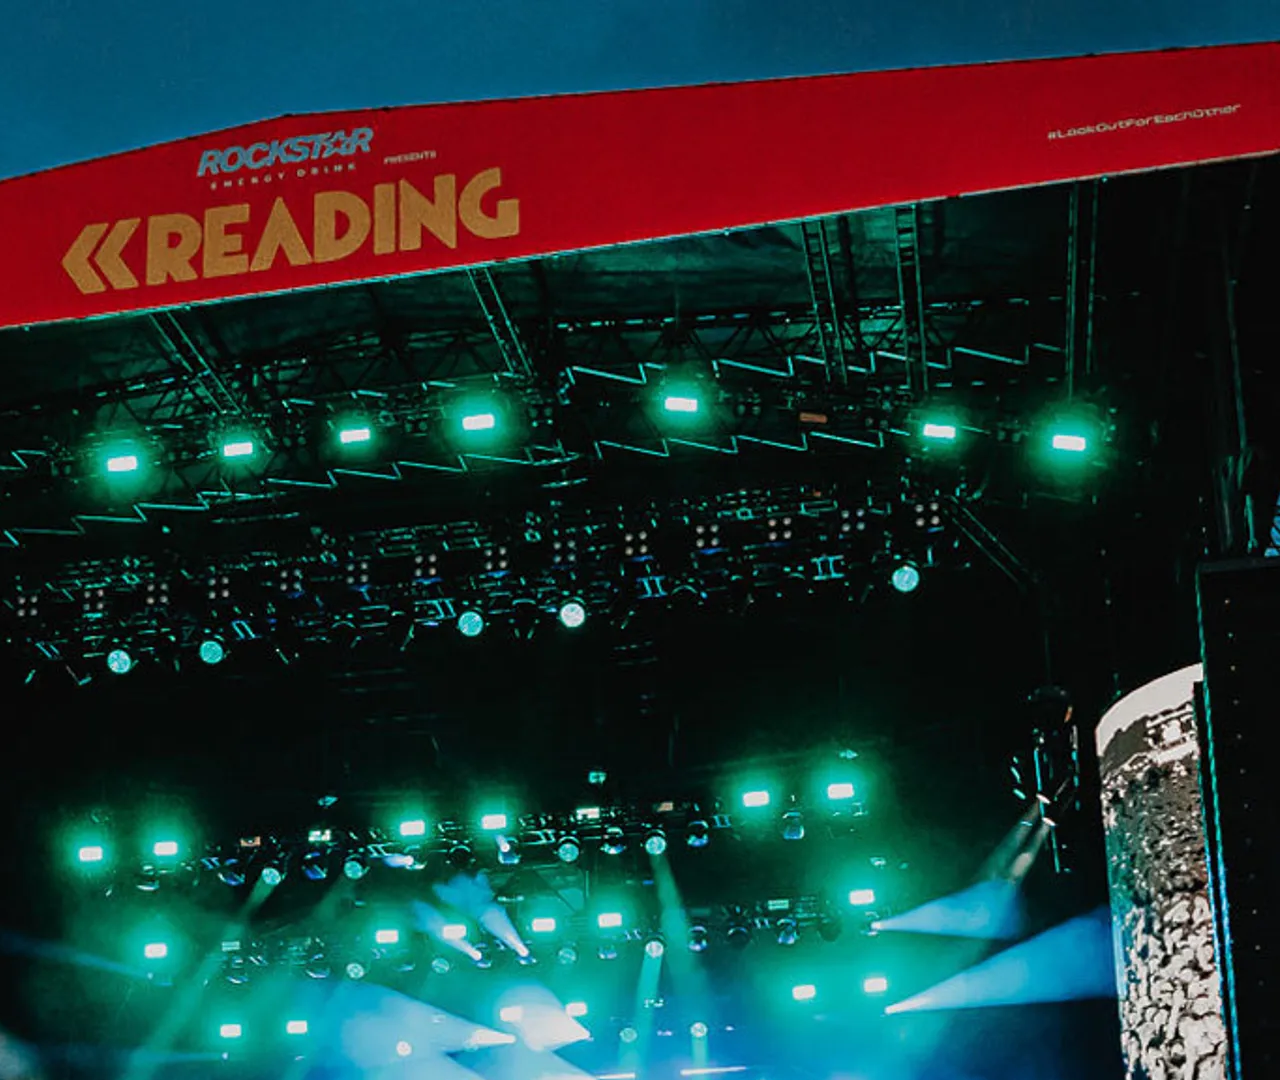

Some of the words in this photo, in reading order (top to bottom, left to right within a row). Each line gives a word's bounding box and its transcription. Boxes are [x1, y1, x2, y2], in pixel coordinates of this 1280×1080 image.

[197, 127, 375, 177] ROCKSTAR
[383, 150, 437, 165] PRESENTS
[210, 171, 286, 190] ENERGY
[296, 163, 357, 178] DRINK
[146, 167, 520, 287] READING
